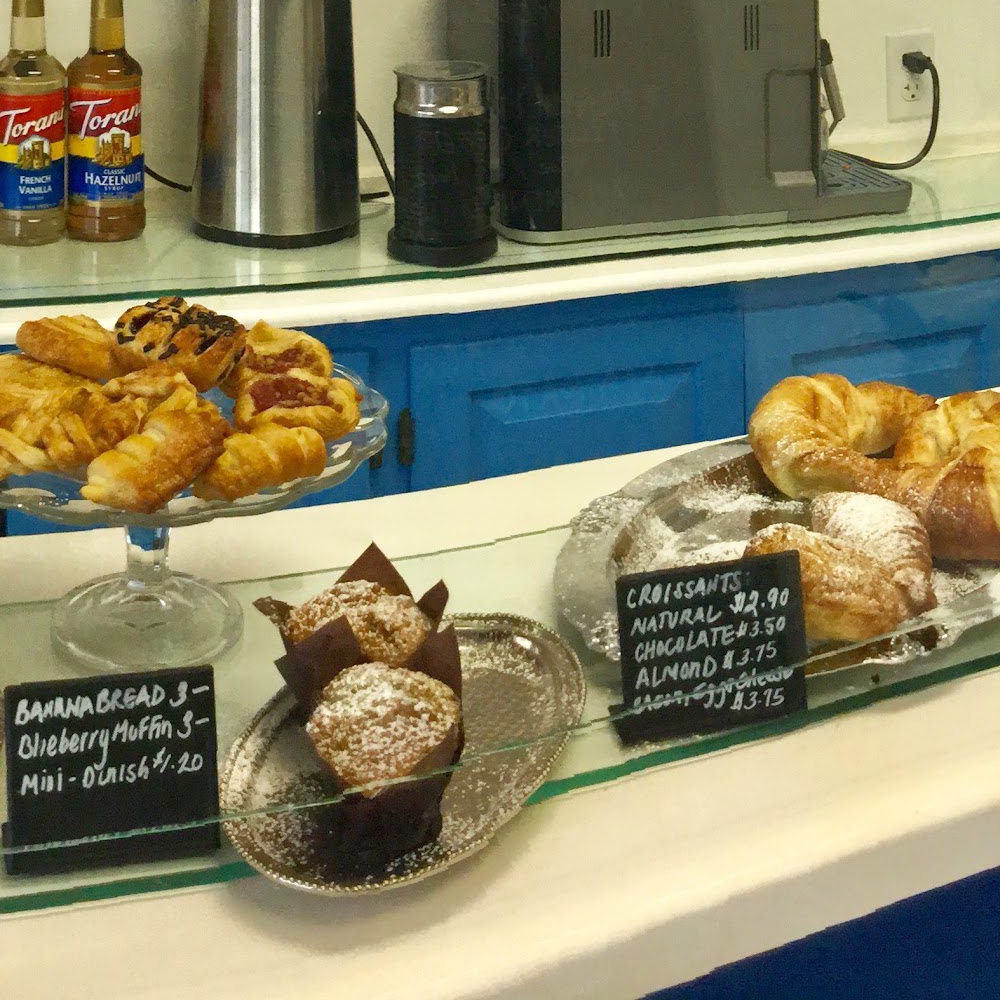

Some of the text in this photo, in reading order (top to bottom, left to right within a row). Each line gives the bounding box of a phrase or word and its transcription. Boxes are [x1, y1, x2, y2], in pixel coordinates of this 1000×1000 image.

[19, 185, 53, 195] VANILLA
[20, 175, 52, 185] FRENCH
[85, 171, 142, 186] HAZELNUT
[630, 605, 722, 637] NATURAL
[634, 624, 735, 663] CHOCOLATE
[635, 655, 717, 690] ALMOND
[15, 695, 94, 726] BANANA
[96, 685, 165, 714] BREAD
